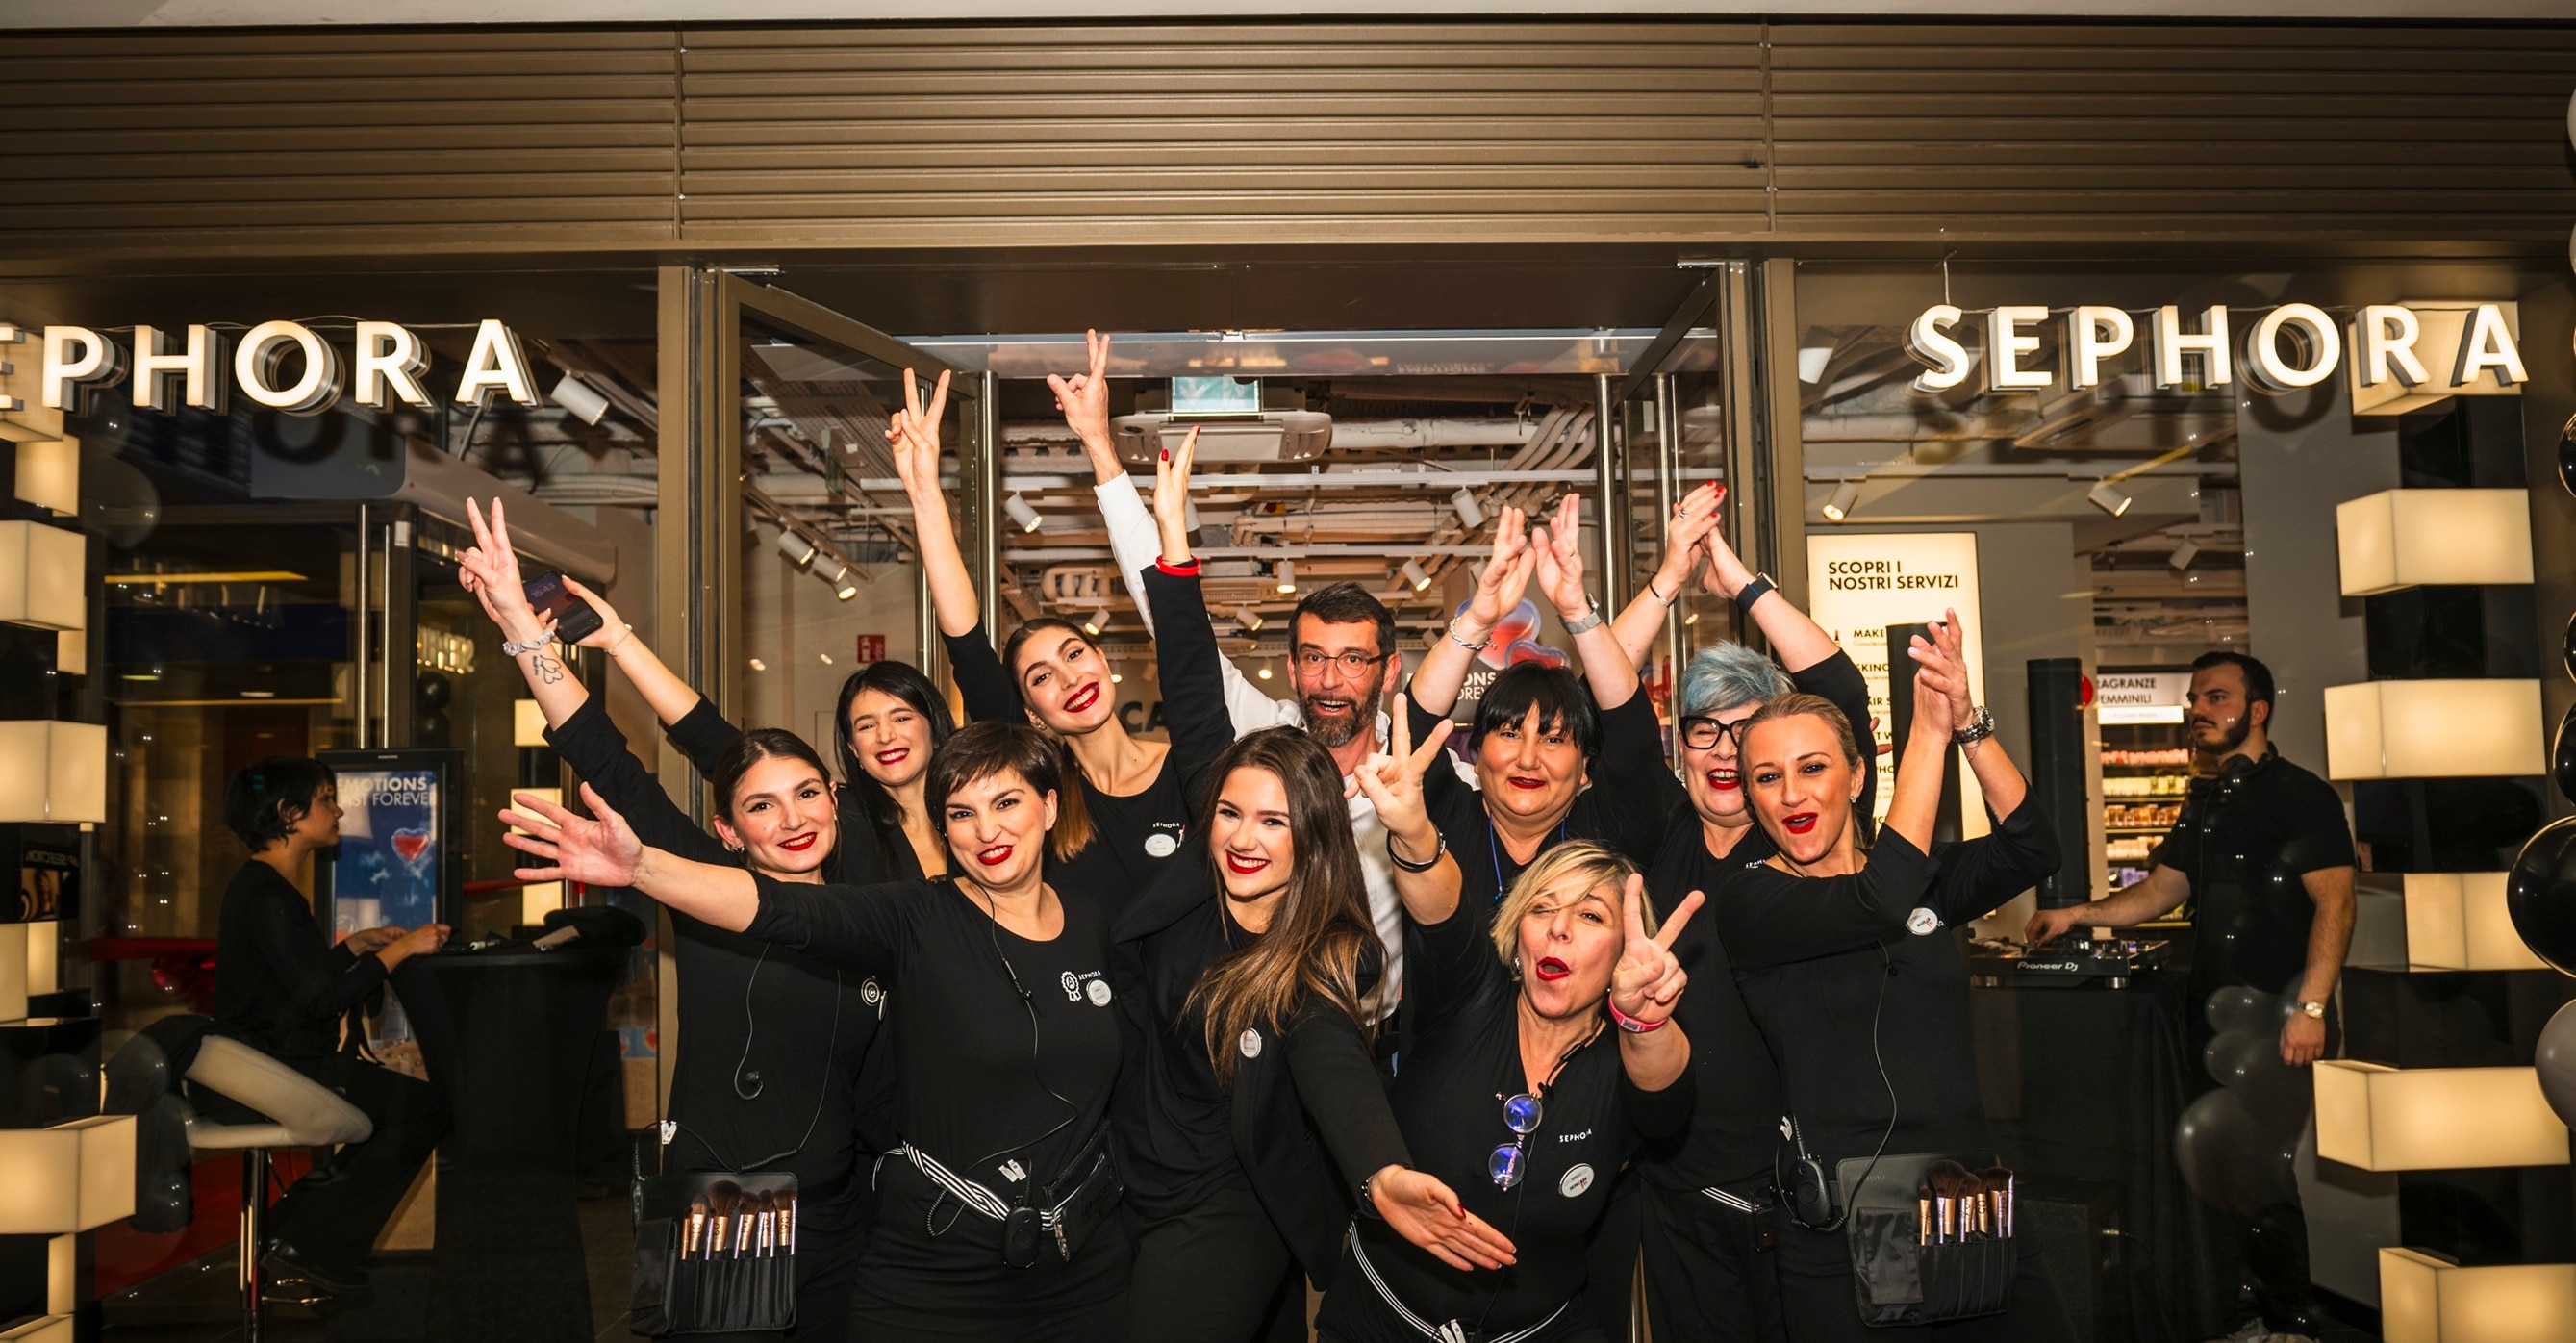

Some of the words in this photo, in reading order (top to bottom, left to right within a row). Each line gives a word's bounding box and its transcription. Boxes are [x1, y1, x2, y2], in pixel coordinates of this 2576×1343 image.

[1912, 303, 2529, 390] SEPHORA
[1828, 561, 1891, 574] SCOPRI
[1897, 560, 1902, 573] I
[1829, 576, 1892, 591] NOSTRI
[1897, 575, 1959, 589] SERVIZI
[1854, 629, 1885, 638] MAKE
[337, 777, 427, 792] EMOTIONS
[2017, 961, 2063, 971] Pioneer
[1559, 1128, 1593, 1143] SEPHOA
